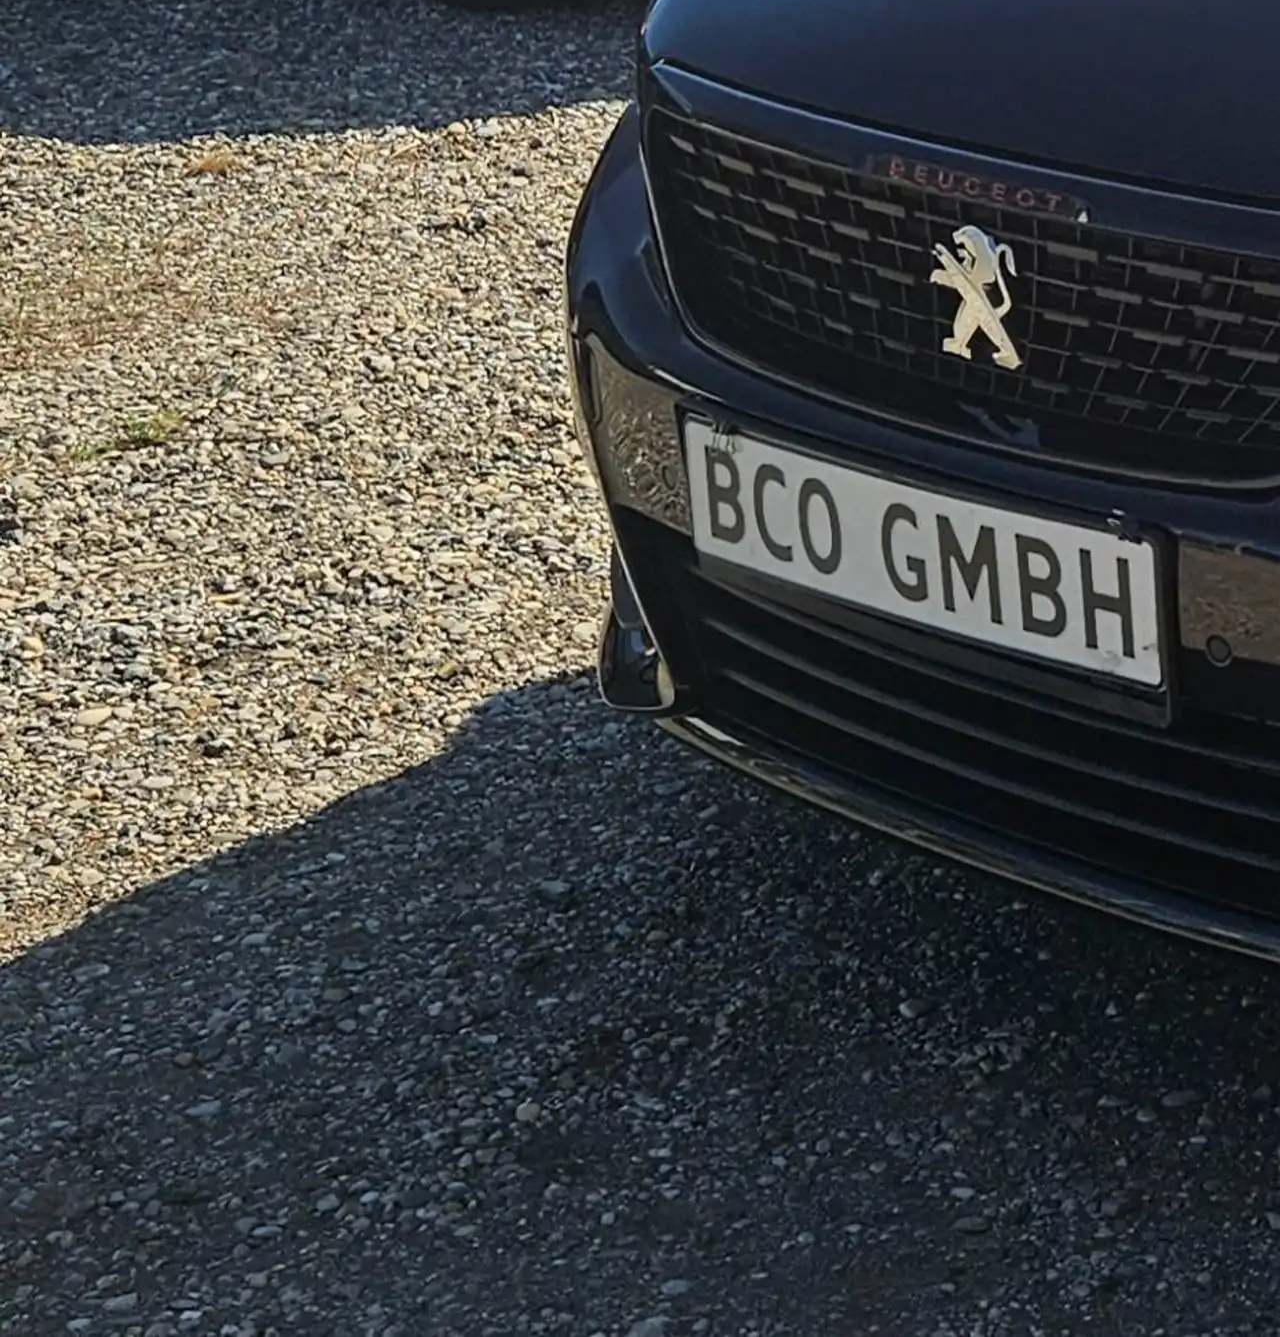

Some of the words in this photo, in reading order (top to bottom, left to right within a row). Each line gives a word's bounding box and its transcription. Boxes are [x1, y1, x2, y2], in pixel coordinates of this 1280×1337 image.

[888, 157, 1063, 212] PEUGEOT
[703, 445, 843, 575] BCO
[880, 502, 1137, 659] GMBH
